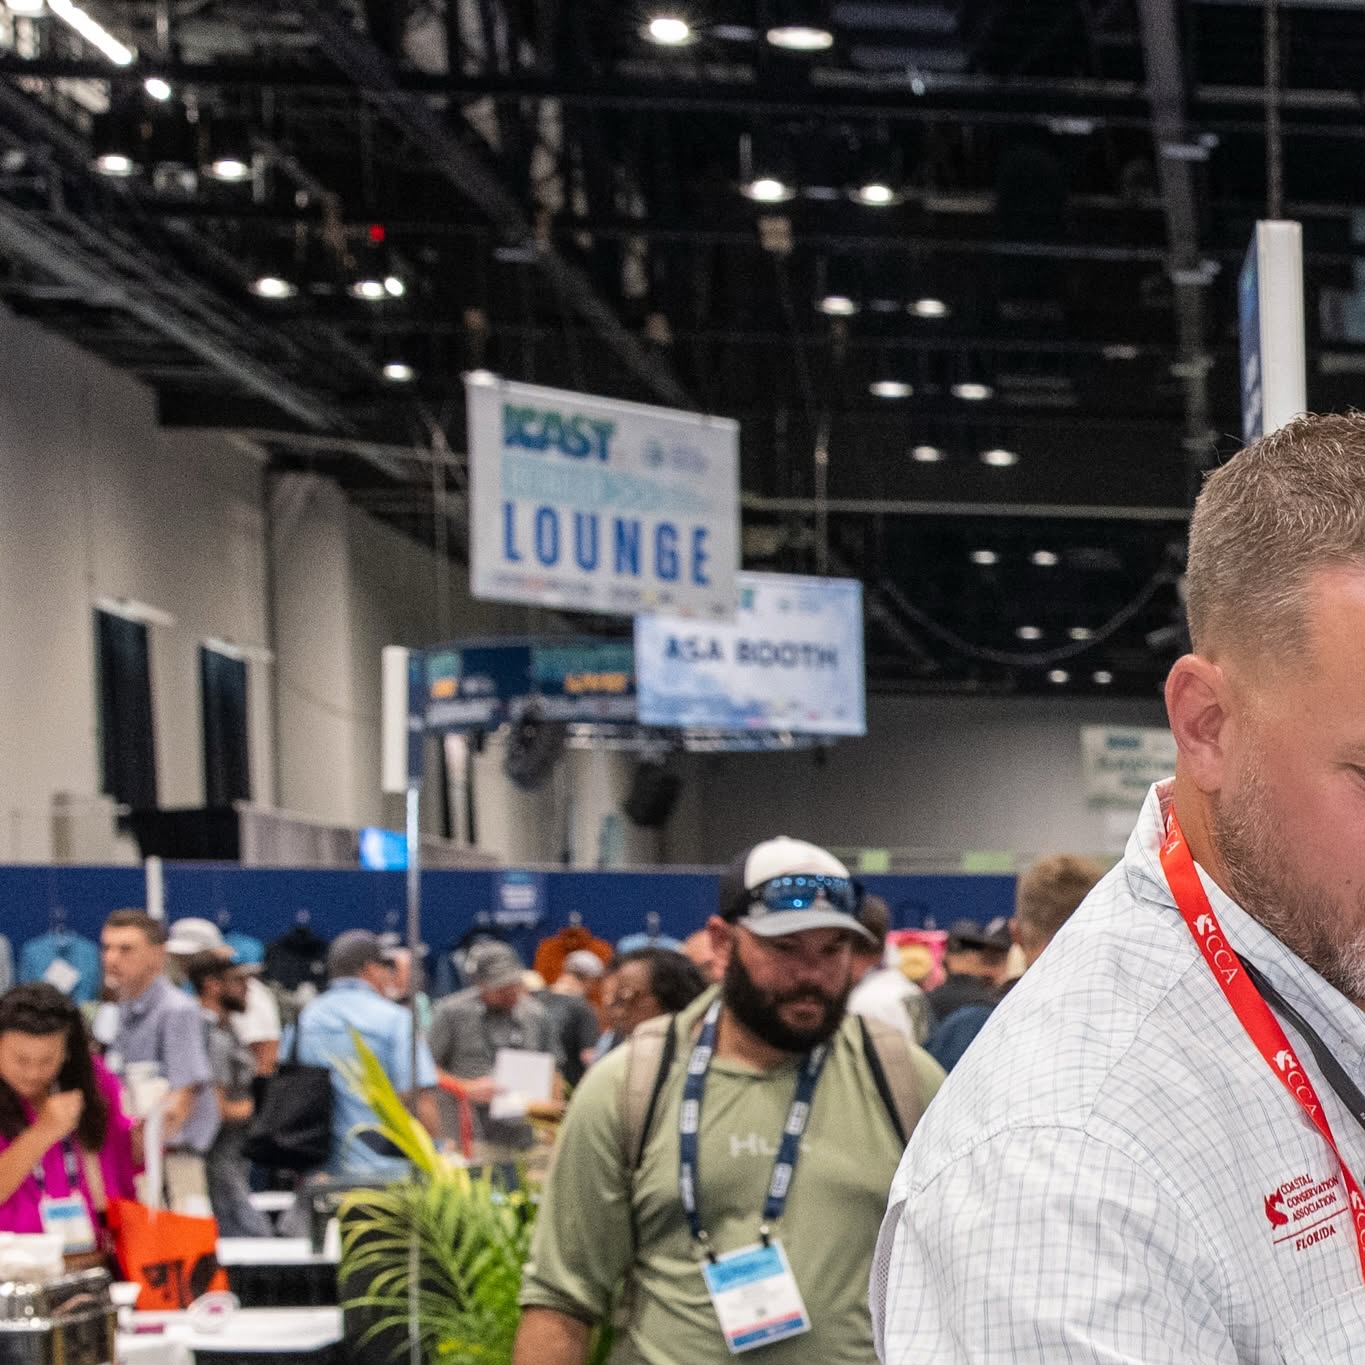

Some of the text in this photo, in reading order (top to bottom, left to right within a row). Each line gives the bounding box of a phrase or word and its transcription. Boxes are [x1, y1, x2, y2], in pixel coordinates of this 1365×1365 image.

[503, 503, 711, 587] LOUNGE
[664, 637, 838, 671] ASA BOOTH
[1205, 933, 1240, 986] CCA
[1286, 1068, 1318, 1118] CCA
[1280, 1173, 1314, 1198] COASTAL
[1286, 1175, 1340, 1210] CONSERVATION
[1292, 1192, 1338, 1222] ASSOCIATION
[1296, 1225, 1337, 1252] FLORIDA
